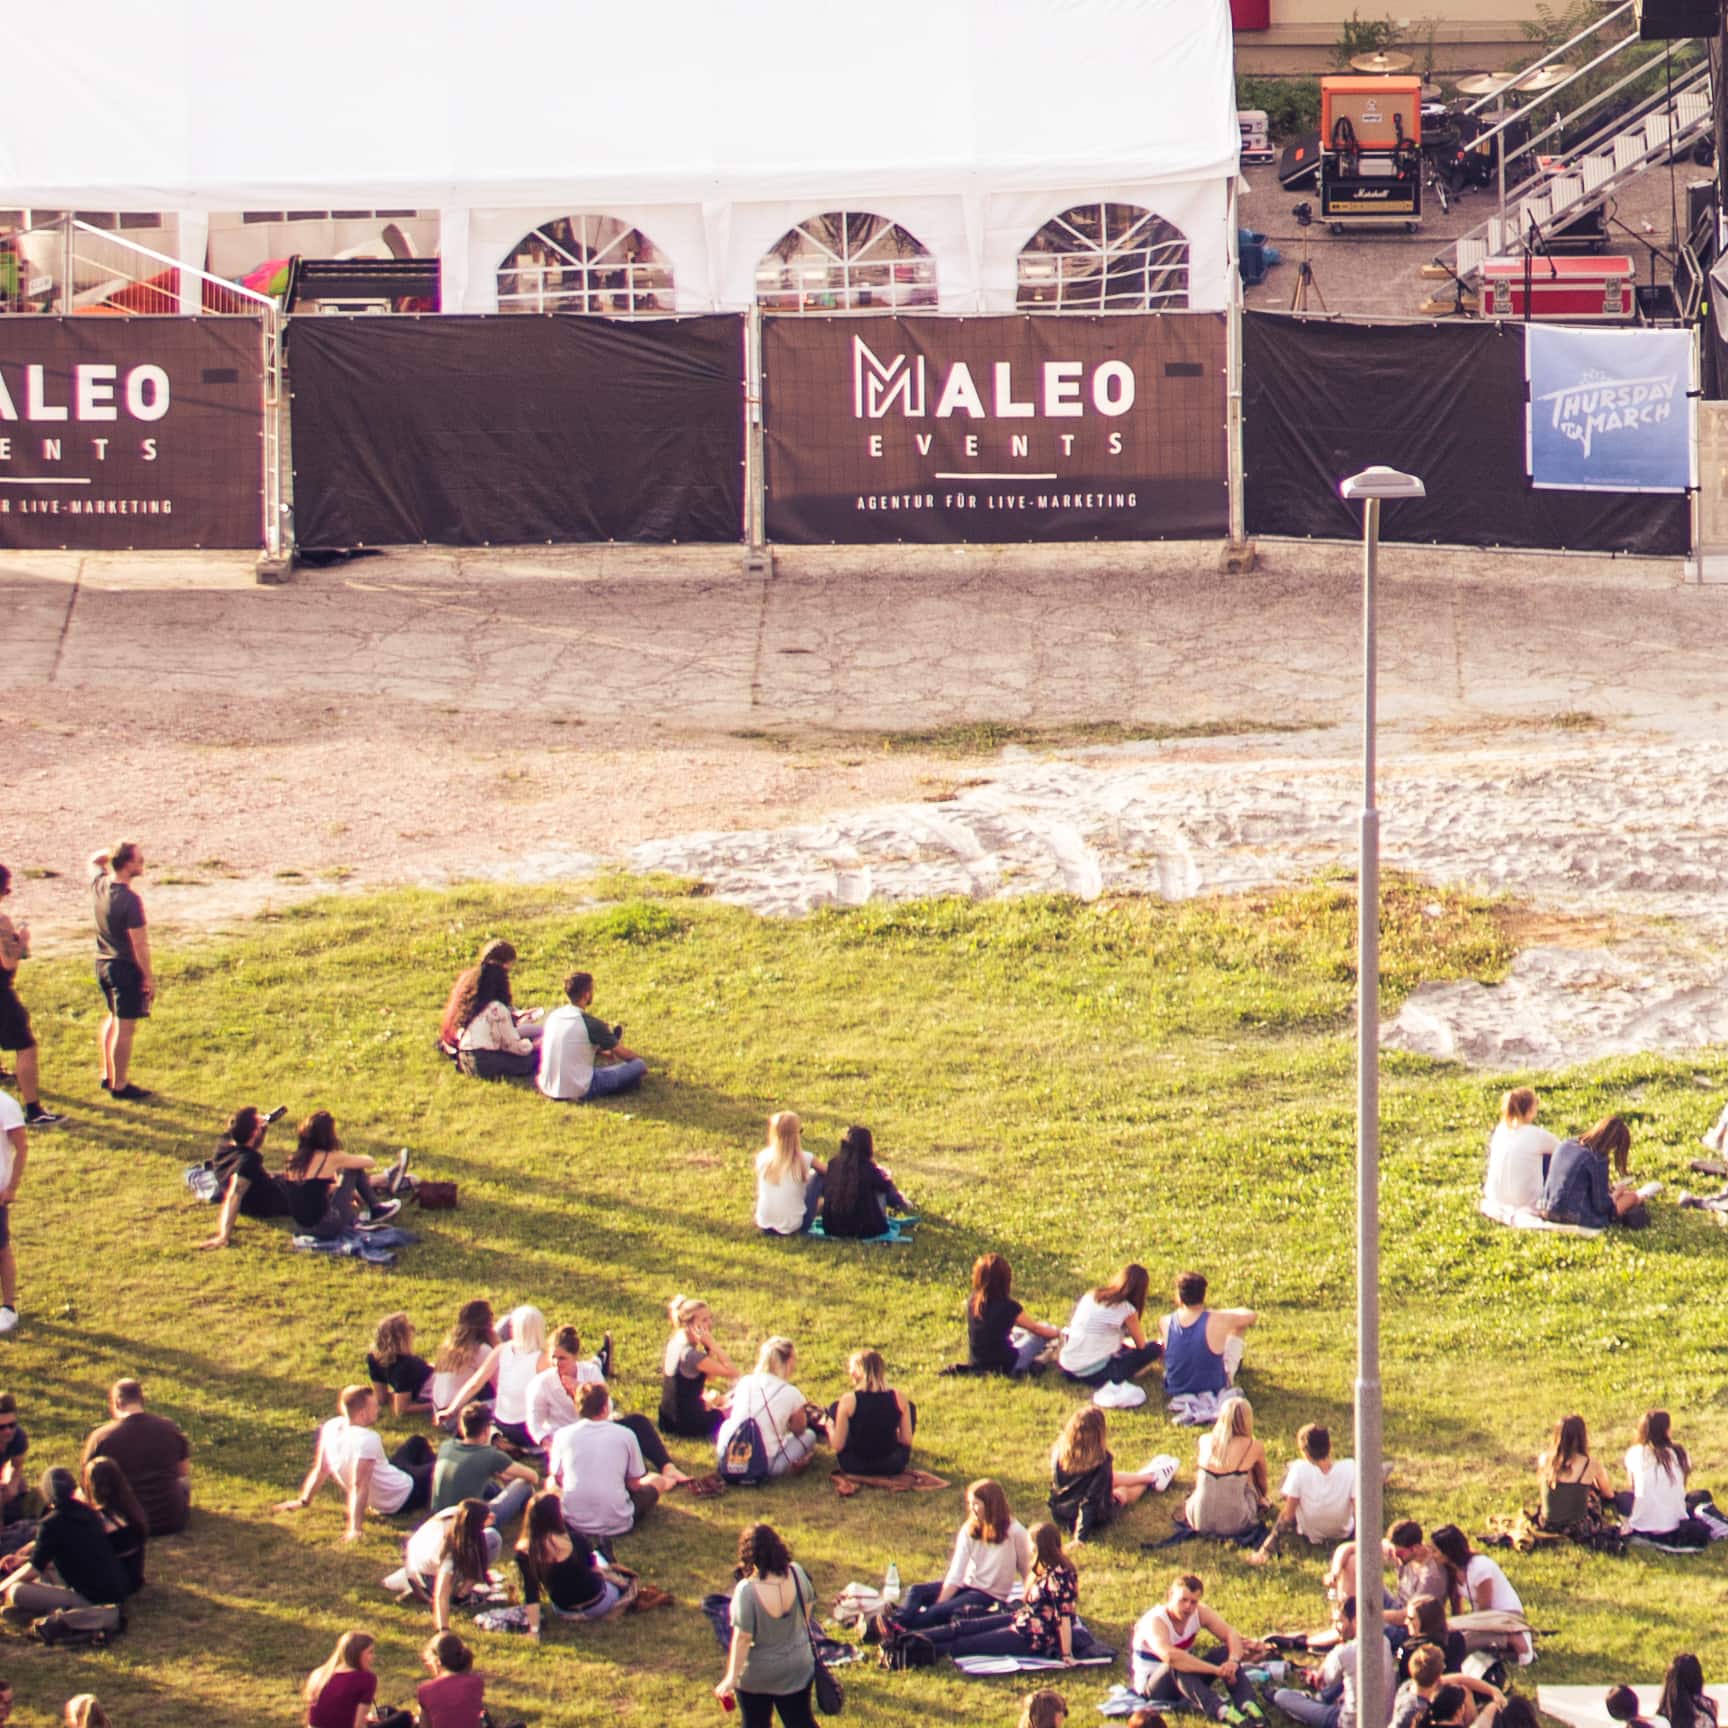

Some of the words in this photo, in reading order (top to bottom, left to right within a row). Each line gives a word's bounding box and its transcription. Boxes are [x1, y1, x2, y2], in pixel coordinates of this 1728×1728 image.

[853, 333, 1136, 419] MALEO
[1536, 372, 1678, 430] THURSDAY
[868, 432, 1123, 458] EVENTS
[1583, 400, 1672, 460] MARCH
[21, 499, 173, 514] LIVE-MARKETING
[856, 494, 935, 510] AGENTUR
[946, 492, 977, 509] FÜR
[989, 493, 1138, 509] LIVE-MARKETING
